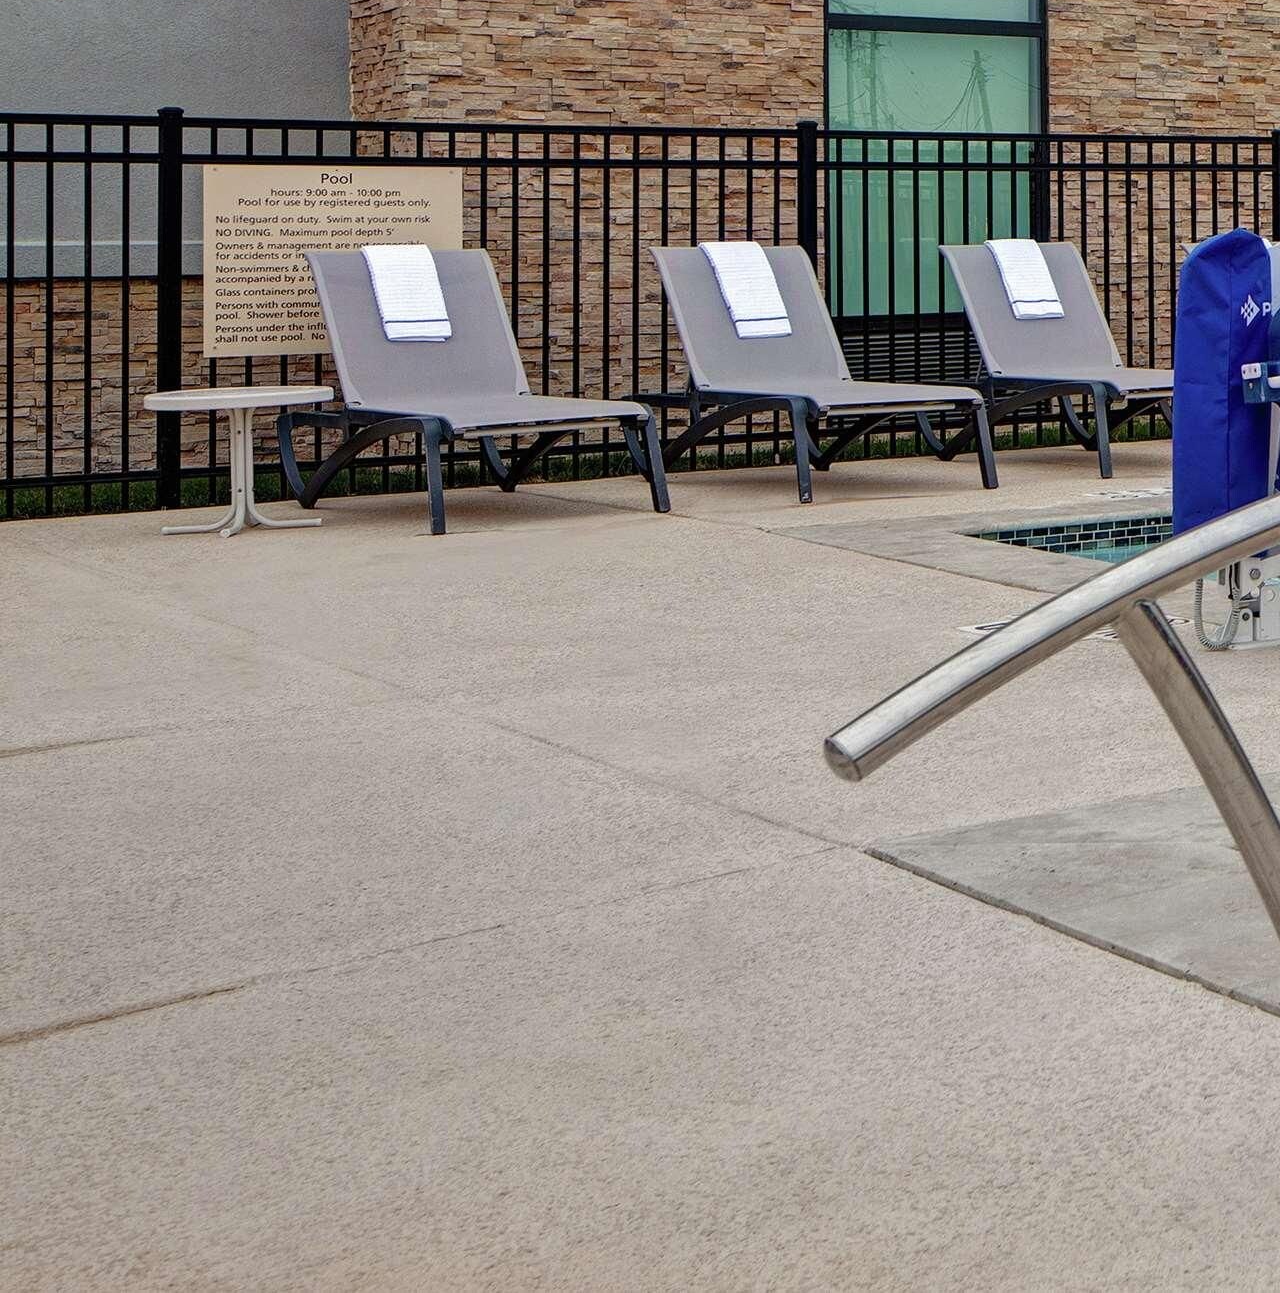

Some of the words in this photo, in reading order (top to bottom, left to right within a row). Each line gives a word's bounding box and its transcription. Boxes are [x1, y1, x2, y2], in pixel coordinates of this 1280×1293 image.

[320, 173, 353, 184] Pool
[270, 188, 303, 197] hours:
[305, 188, 328, 197] 9:00
[357, 188, 382, 197] 10:00
[385, 190, 401, 198] pm
[238, 198, 262, 206] Pool
[265, 198, 280, 206] for
[303, 198, 317, 208] by
[319, 198, 371, 208] registered
[373, 199, 406, 208] guests
[407, 198, 431, 208] only.
[232, 215, 279, 225] lifeguard
[297, 215, 321, 225] duty.
[326, 215, 353, 223] Swim
[367, 217, 388, 225] your
[215, 229, 232, 237] NO
[280, 228, 328, 237] Maximum
[331, 228, 353, 237] pool
[355, 228, 384, 237] depth
[215, 242, 254, 250] Owners
[256, 242, 264, 250] &
[267, 243, 332, 251] management
[215, 252, 231, 260] for
[233, 252, 279, 260] accidents
[215, 265, 289, 273] Non-swimmers
[292, 264, 299, 272] &
[215, 274, 282, 284] accompanied
[284, 274, 296, 283] by
[215, 288, 241, 297] Glass
[243, 287, 295, 296] containers
[215, 301, 253, 310] Persons
[255, 300, 278, 309] with
[215, 311, 241, 321] pool.
[247, 310, 284, 319] Shower
[287, 309, 320, 318] before
[215, 325, 253, 334] Persons
[256, 323, 286, 332] under
[288, 323, 304, 331] the
[215, 334, 238, 343] shall
[280, 333, 305, 343] pool.
[311, 332, 326, 340] No
